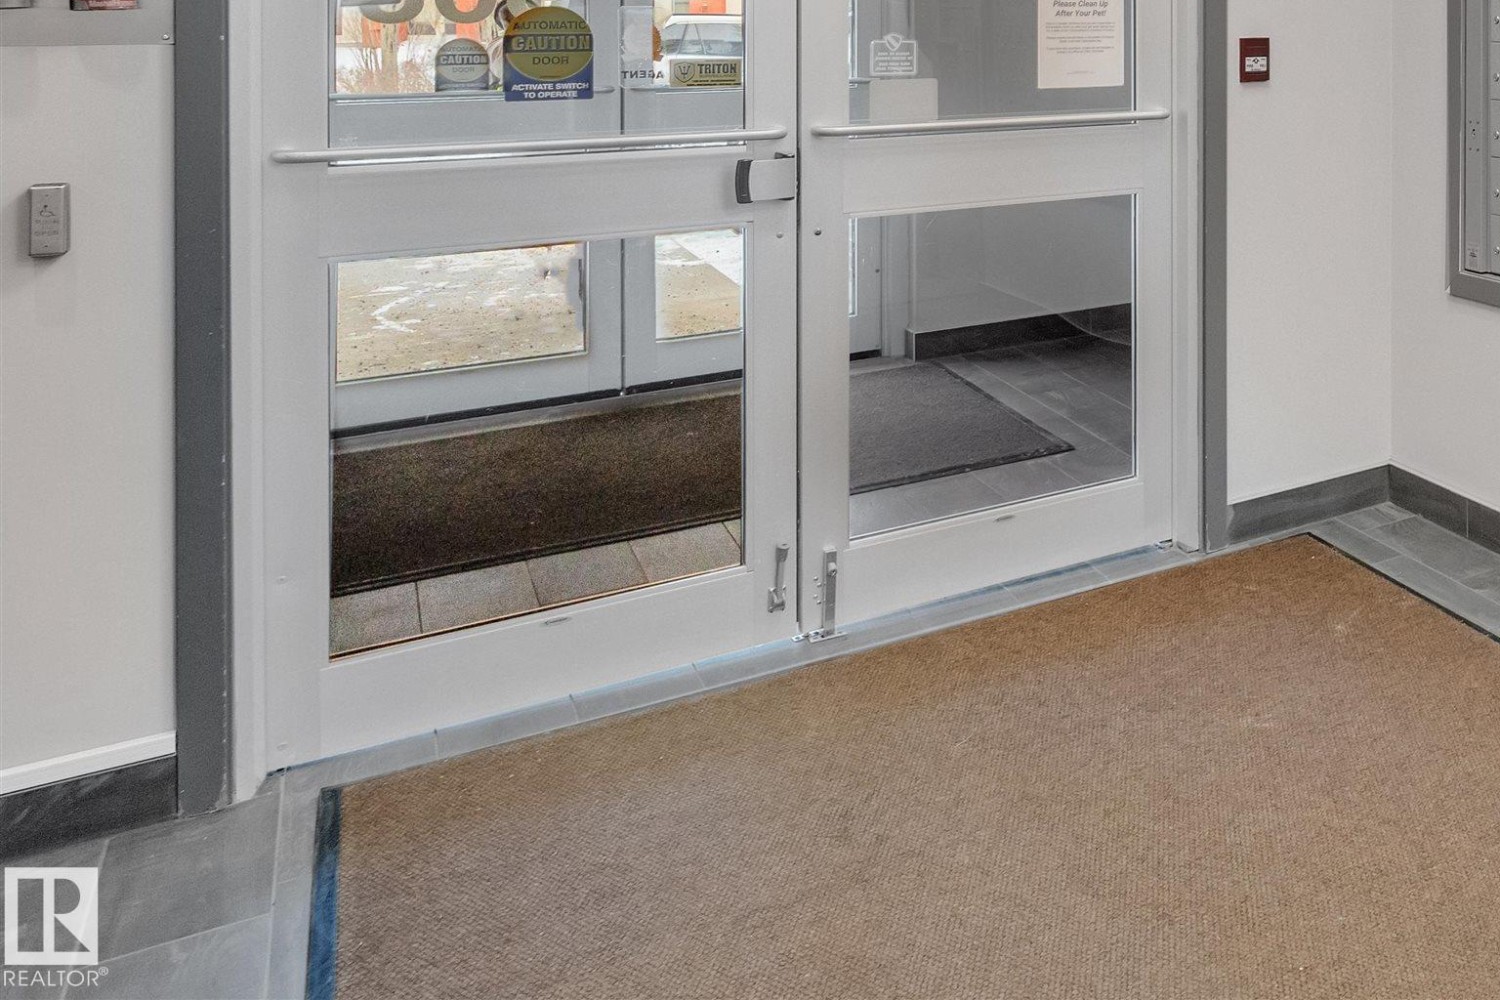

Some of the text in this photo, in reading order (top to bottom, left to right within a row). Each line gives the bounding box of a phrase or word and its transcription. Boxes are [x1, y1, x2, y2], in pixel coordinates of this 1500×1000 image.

[1053, 0, 1077, 7] Please
[1099, 0, 1109, 8] Up
[513, 20, 587, 31] AUTOMATIC
[511, 35, 592, 51] CAUTION
[440, 54, 488, 65] CAUTION
[532, 56, 570, 66] DOOR
[697, 63, 737, 74] TRITON
[511, 82, 590, 92] ACTIVATE SWITCH
[537, 90, 579, 99] OPERATE
